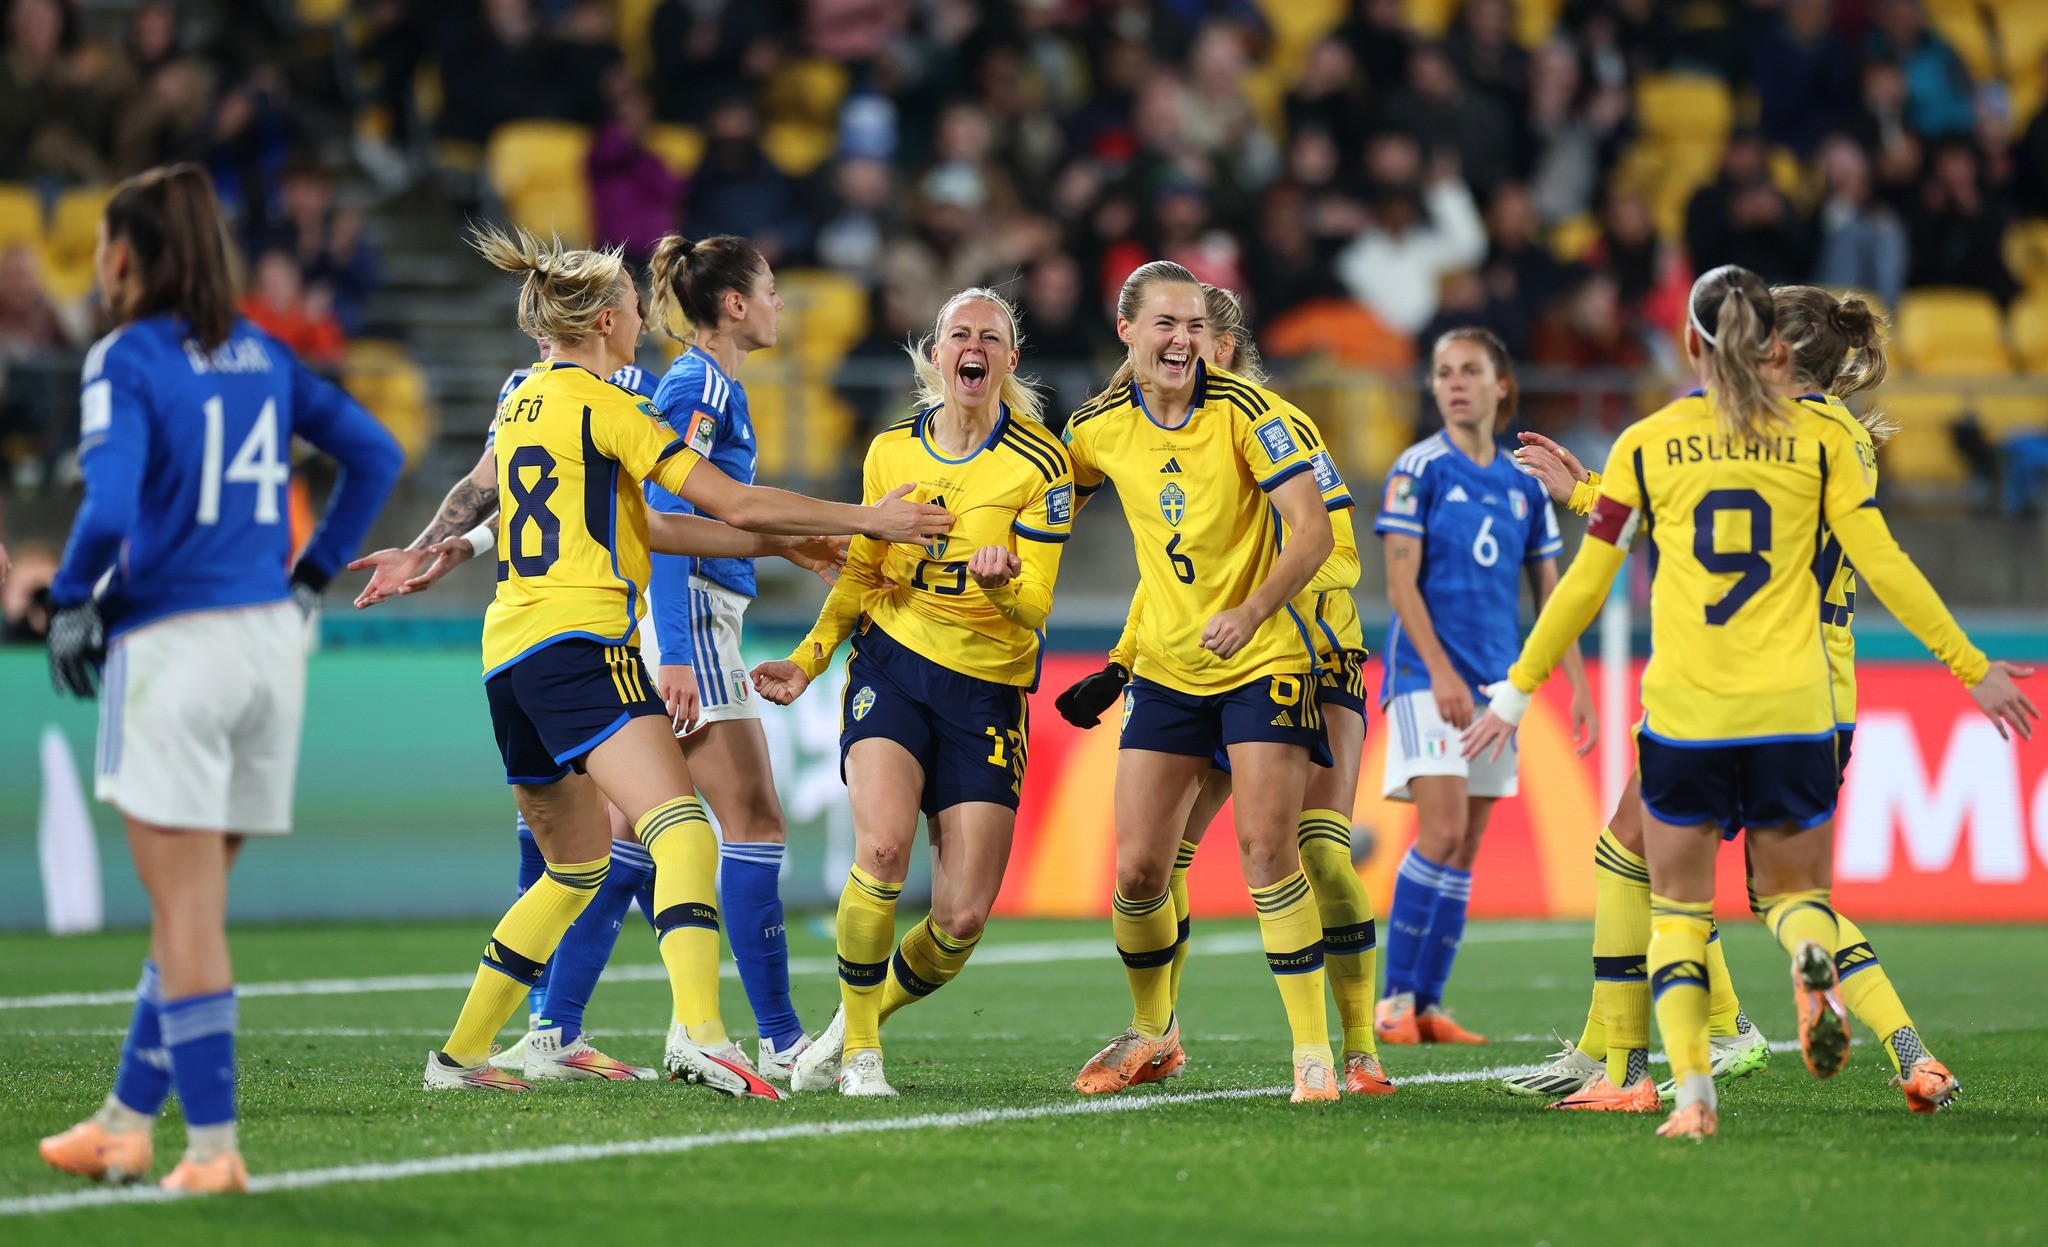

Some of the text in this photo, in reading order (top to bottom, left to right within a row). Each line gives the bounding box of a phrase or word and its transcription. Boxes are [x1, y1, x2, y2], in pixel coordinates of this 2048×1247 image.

[196, 394, 289, 525] 14
[497, 446, 560, 582] 8
[1166, 533, 1195, 584] 6
[1472, 515, 1499, 567] 6
[1693, 489, 1771, 626] 9
[1836, 710, 2048, 883] M
